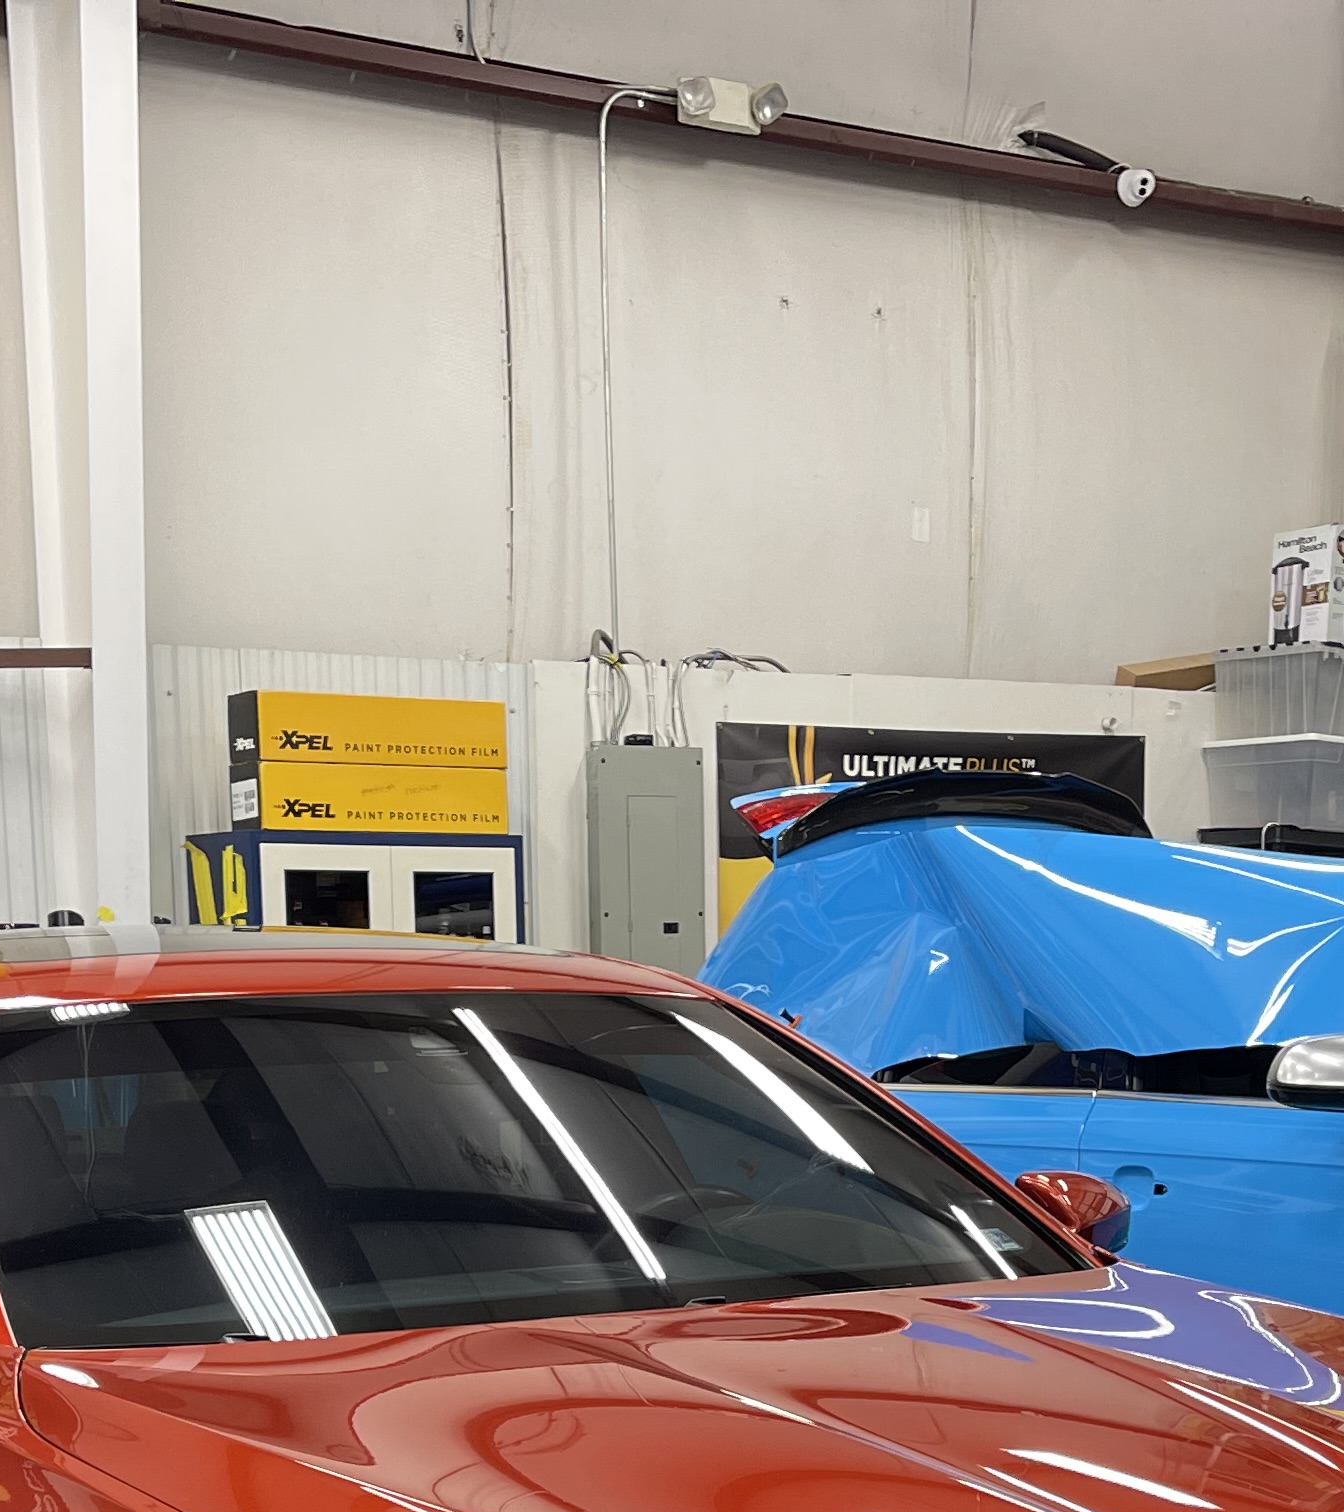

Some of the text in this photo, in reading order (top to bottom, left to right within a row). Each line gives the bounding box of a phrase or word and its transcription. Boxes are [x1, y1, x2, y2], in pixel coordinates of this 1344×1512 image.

[1299, 542, 1327, 553] Beach
[279, 730, 499, 757] XPEL PAINT PROTECTION FILM
[282, 798, 500, 823] XPEL PAINT PROTECTION FILM
